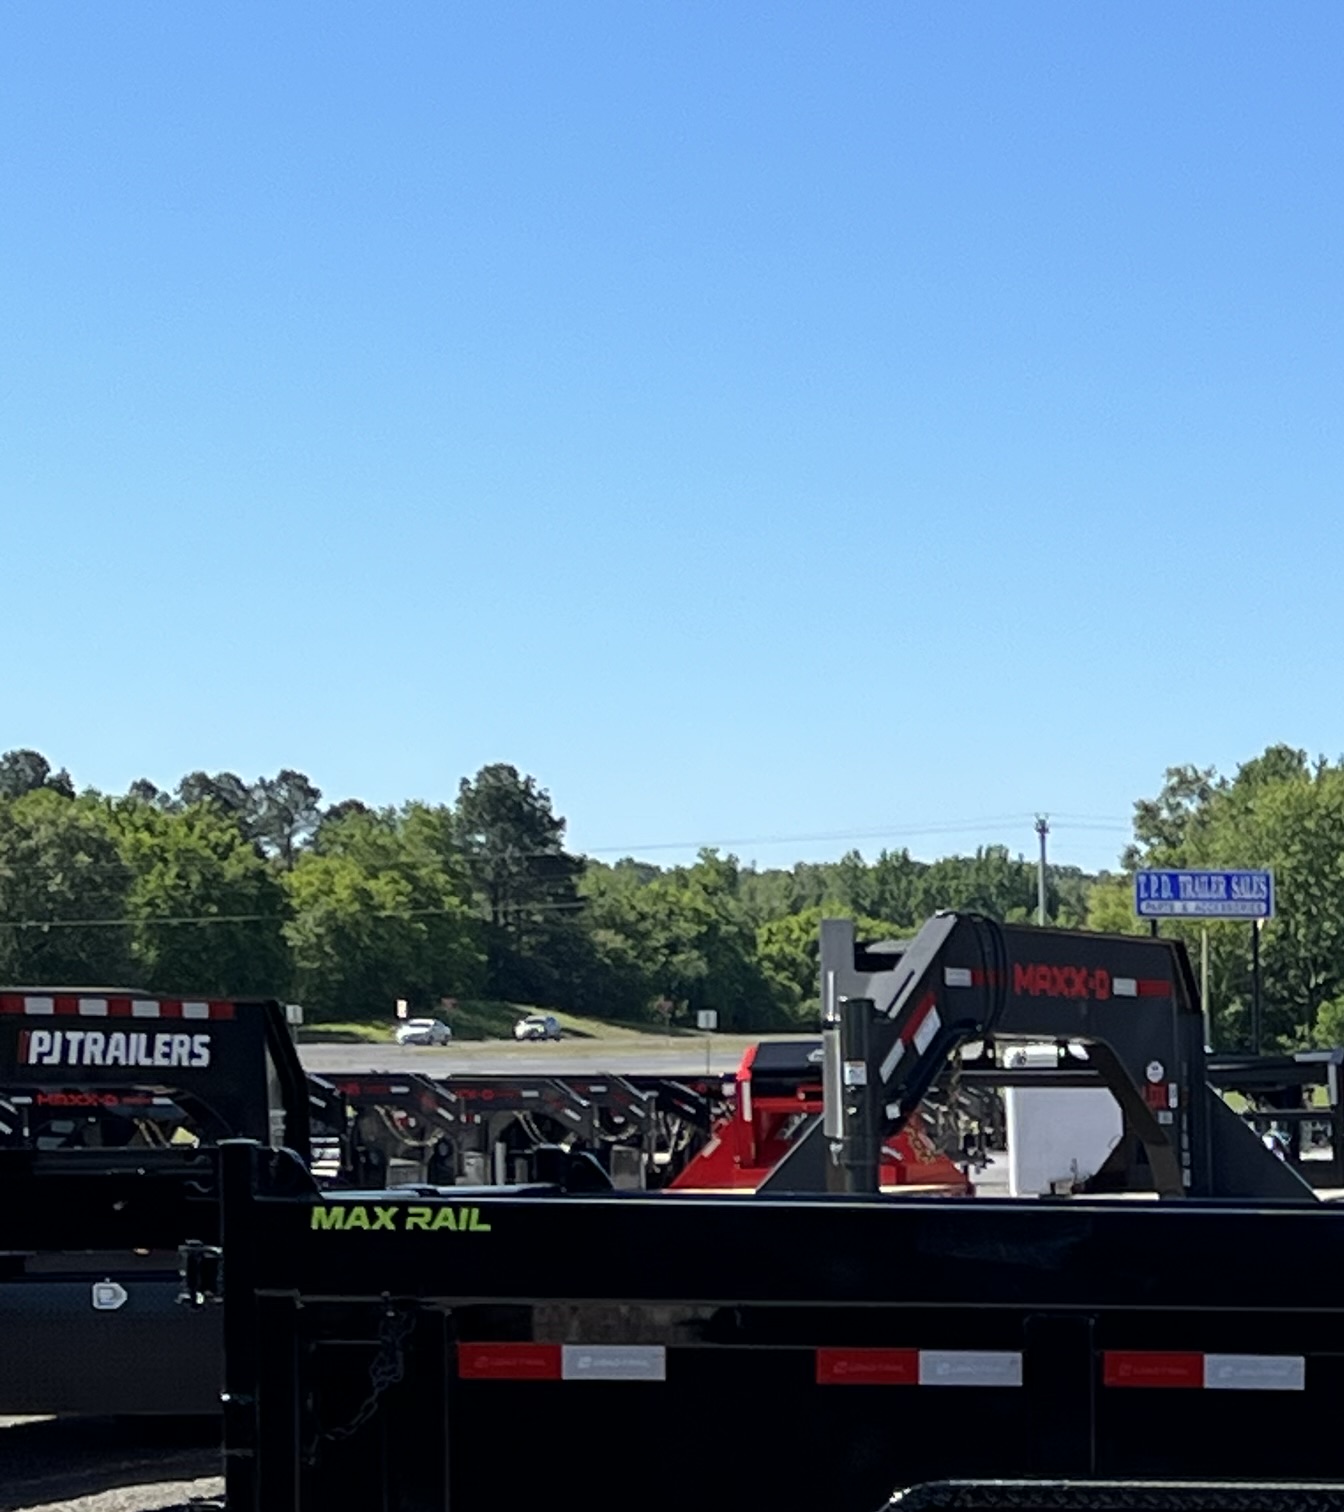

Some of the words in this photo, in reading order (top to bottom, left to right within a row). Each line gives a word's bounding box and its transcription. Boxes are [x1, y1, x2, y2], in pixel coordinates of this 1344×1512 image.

[1178, 875, 1227, 900] TRAILER
[1231, 875, 1267, 899] SALES
[310, 1206, 399, 1231] MAX
[405, 1206, 491, 1231] RAIL
